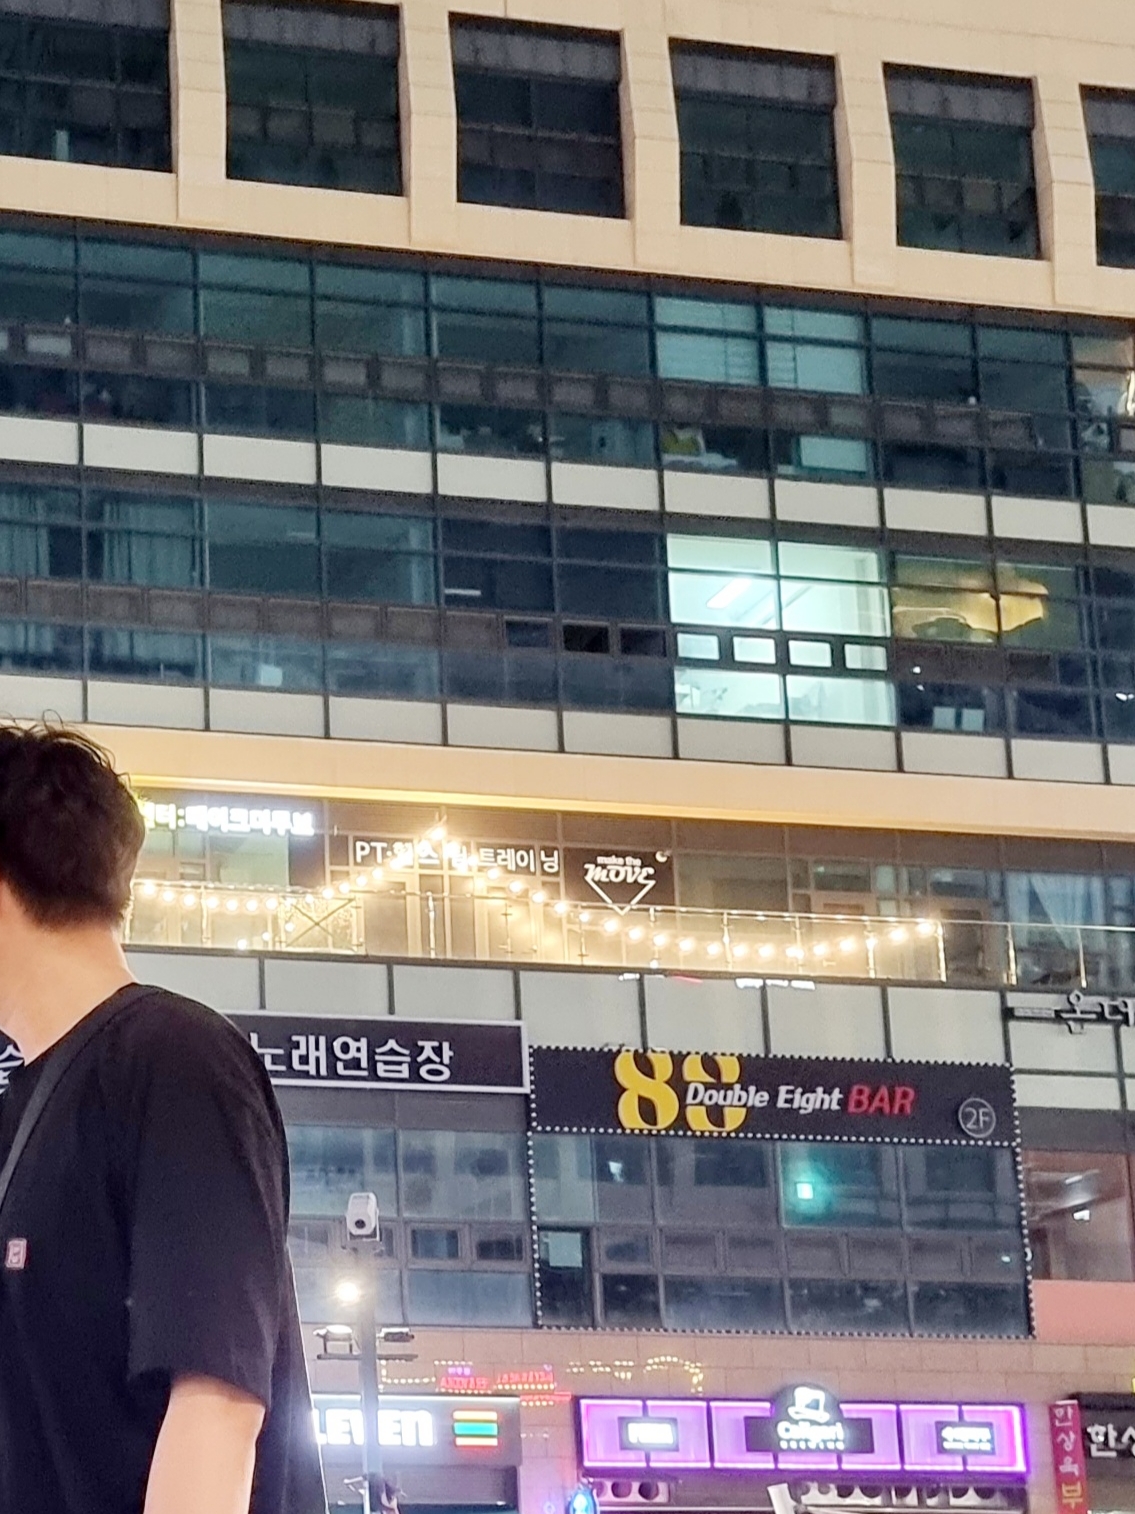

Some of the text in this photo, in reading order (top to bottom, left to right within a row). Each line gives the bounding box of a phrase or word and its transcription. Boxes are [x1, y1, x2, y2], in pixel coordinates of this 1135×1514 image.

[249, 1032, 455, 1082] 노래연습장
[685, 1082, 917, 1117] Double Eight BAR
[965, 1106, 992, 1131] 2F
